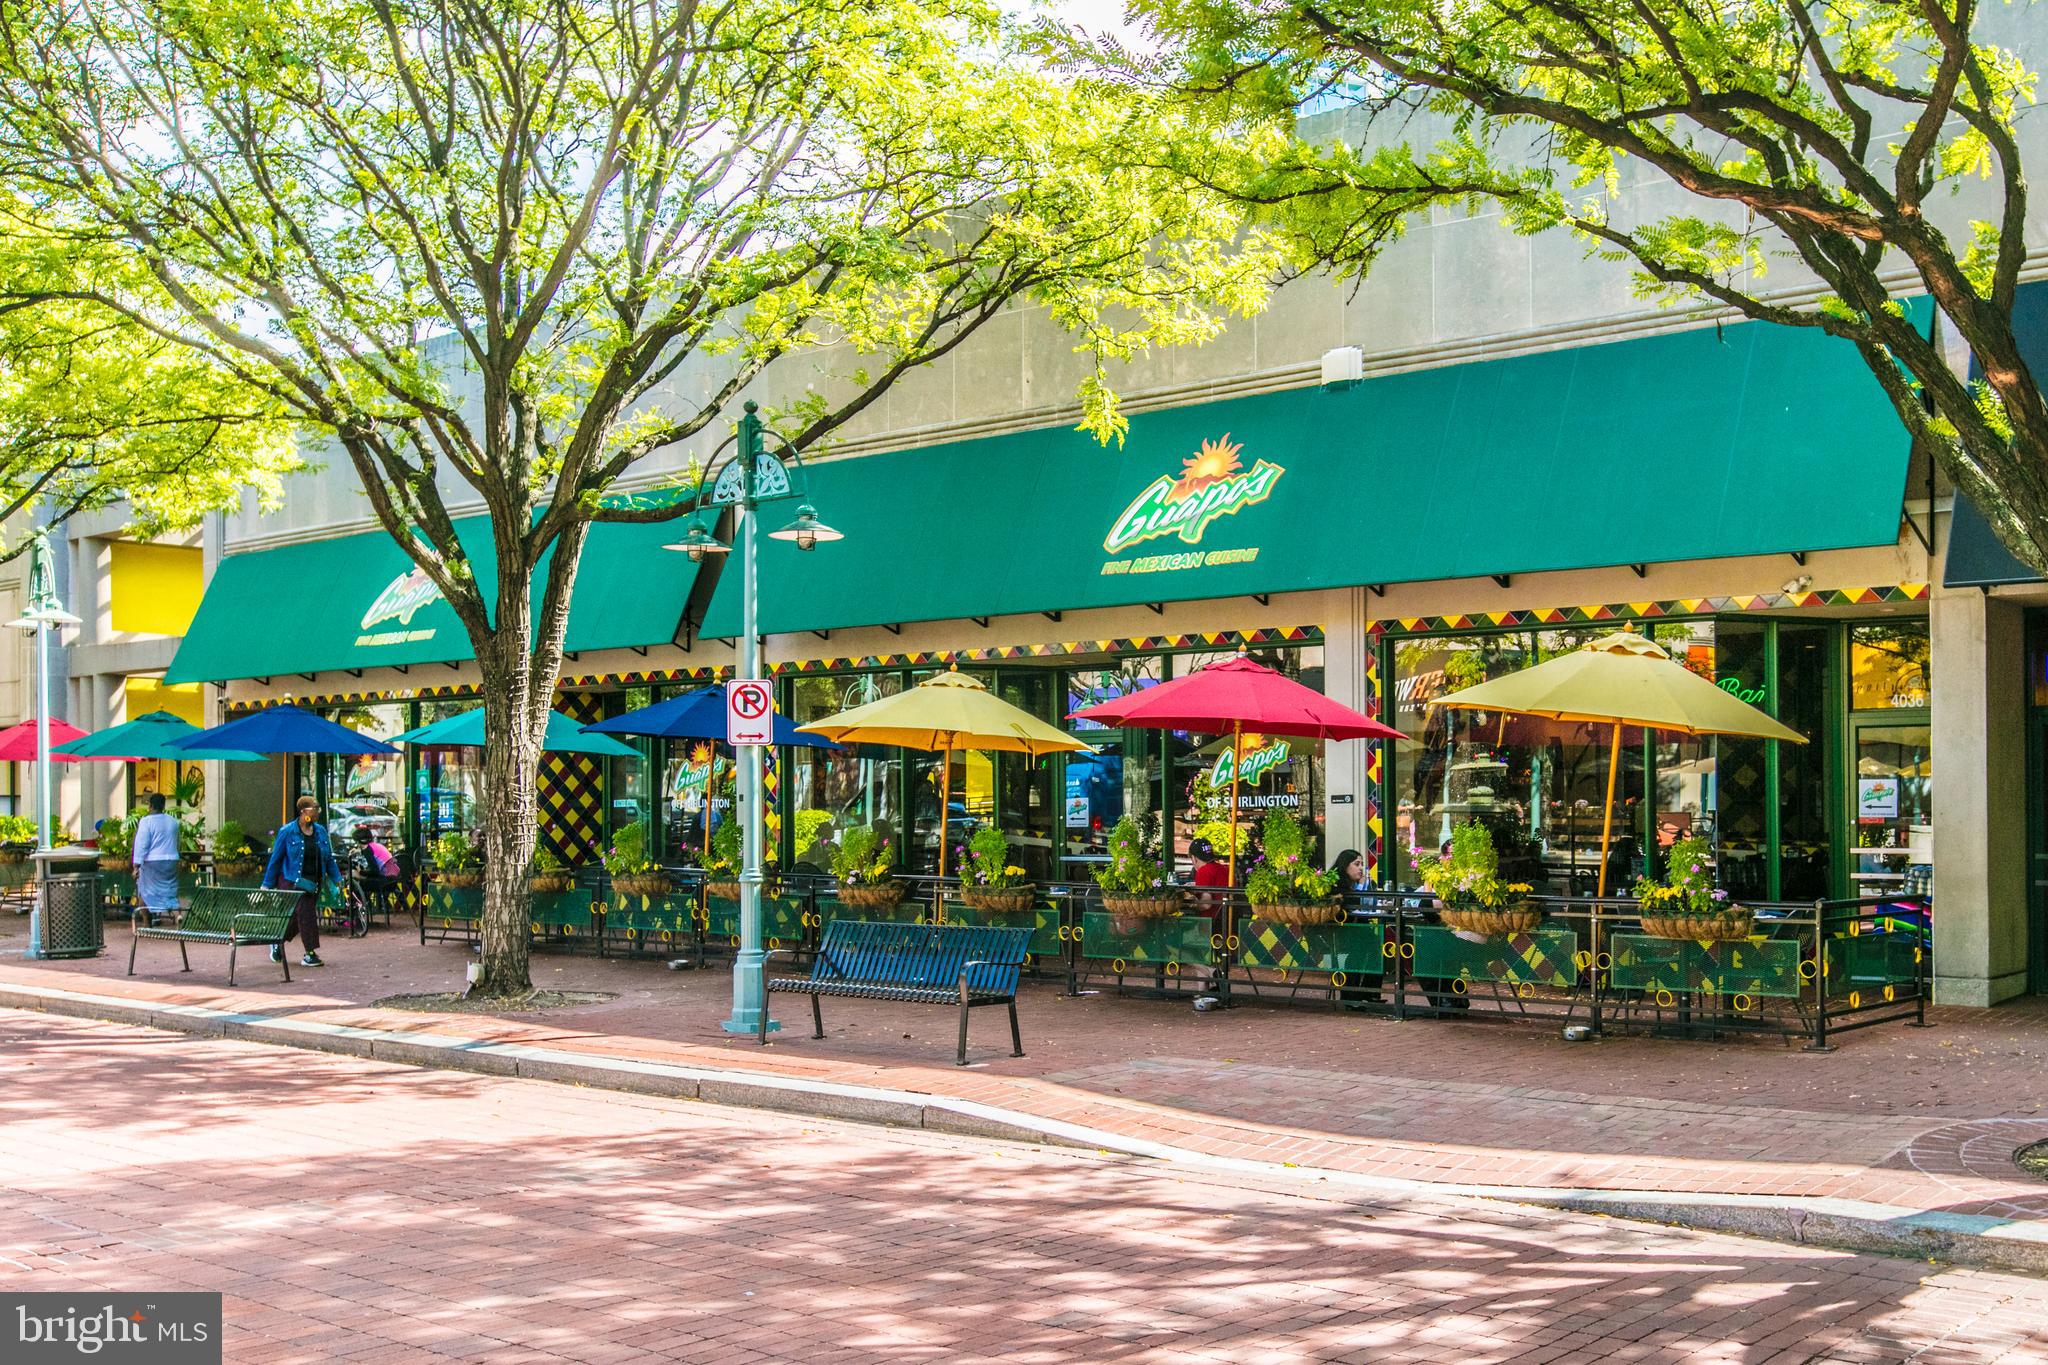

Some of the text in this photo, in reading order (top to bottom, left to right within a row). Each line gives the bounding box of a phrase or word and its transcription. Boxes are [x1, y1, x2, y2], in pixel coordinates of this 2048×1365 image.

[1106, 463, 1278, 550] Guapo's
[1101, 548, 1259, 575] FINE MEXICAN CUISINE
[1891, 694, 1925, 707] 4036
[674, 757, 724, 791] Guap's
[1210, 741, 1287, 788] Guapo's
[1206, 797, 1221, 808] OF
